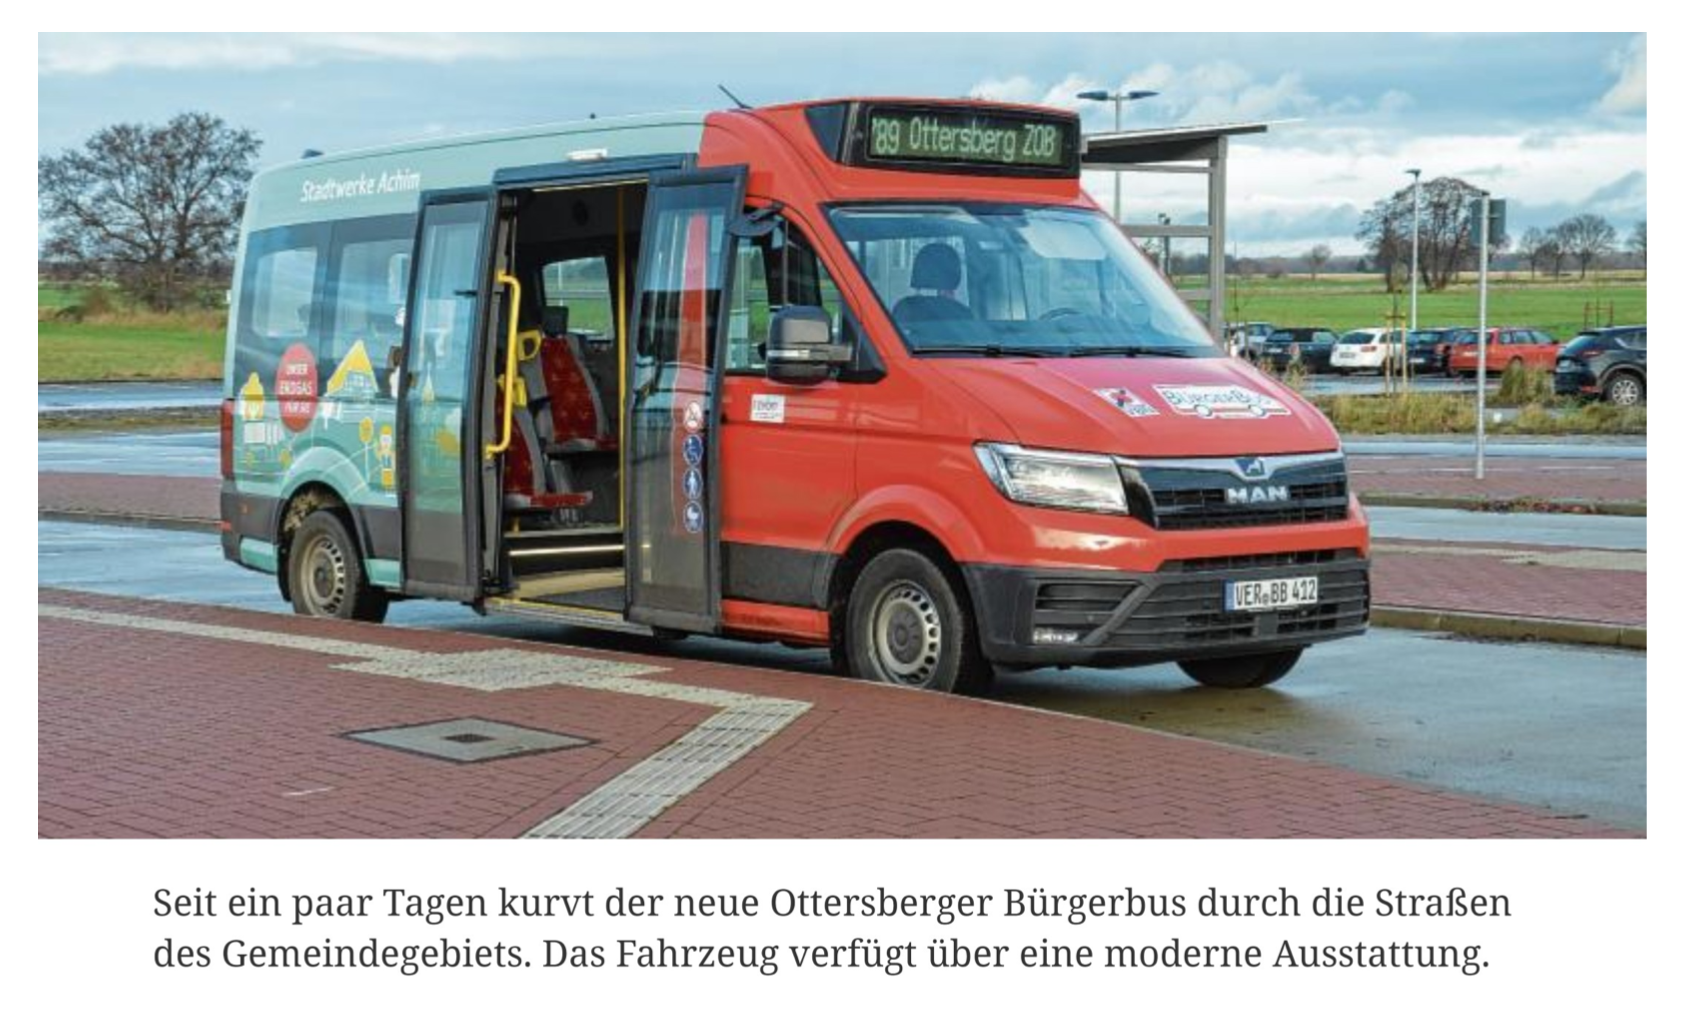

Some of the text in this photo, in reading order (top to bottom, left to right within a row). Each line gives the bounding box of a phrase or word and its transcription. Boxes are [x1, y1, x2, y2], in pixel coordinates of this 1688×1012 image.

[909, 116, 1016, 163] Ottersberg
[1022, 123, 1056, 157] ZOB
[300, 168, 420, 202] Stadtwerke Achim
[1227, 485, 1290, 504] MAN
[1235, 579, 1316, 606] VER BB 412
